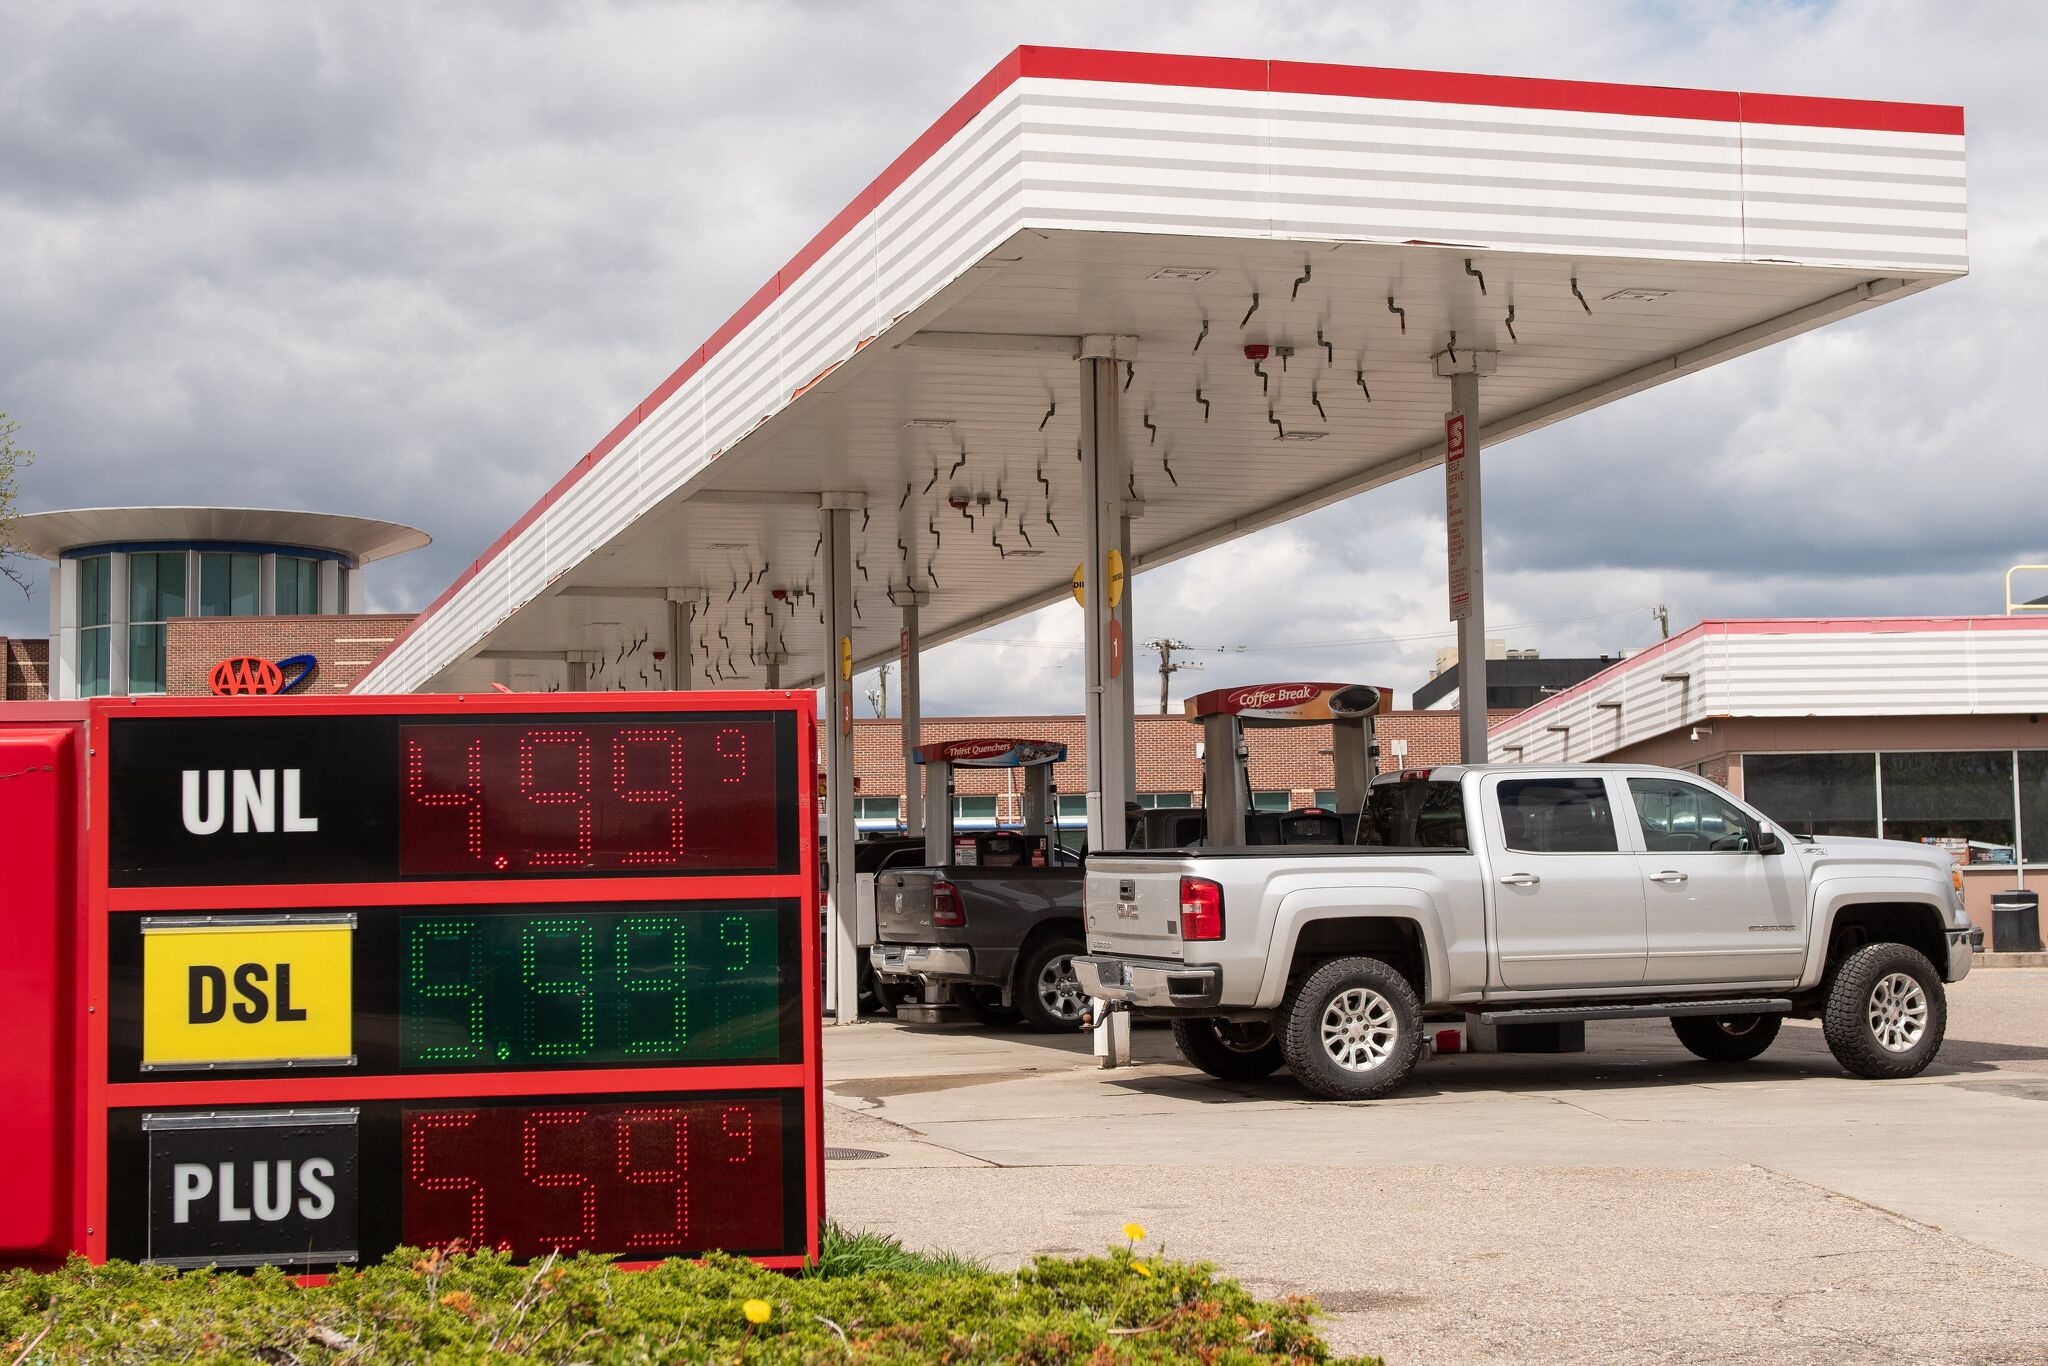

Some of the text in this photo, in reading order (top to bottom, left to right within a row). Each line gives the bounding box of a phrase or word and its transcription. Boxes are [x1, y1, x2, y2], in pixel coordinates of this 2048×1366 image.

[1448, 461, 1460, 473] SELF
[1448, 471, 1464, 485] SERVE
[1113, 638, 1118, 657] 1
[212, 657, 280, 695] AAA
[1240, 686, 1311, 707] Coffee Break
[949, 743, 1011, 757] Thirst Quenchers
[182, 768, 318, 836] UNL
[188, 962, 307, 1025] DSL
[173, 1156, 336, 1224] PLUS
